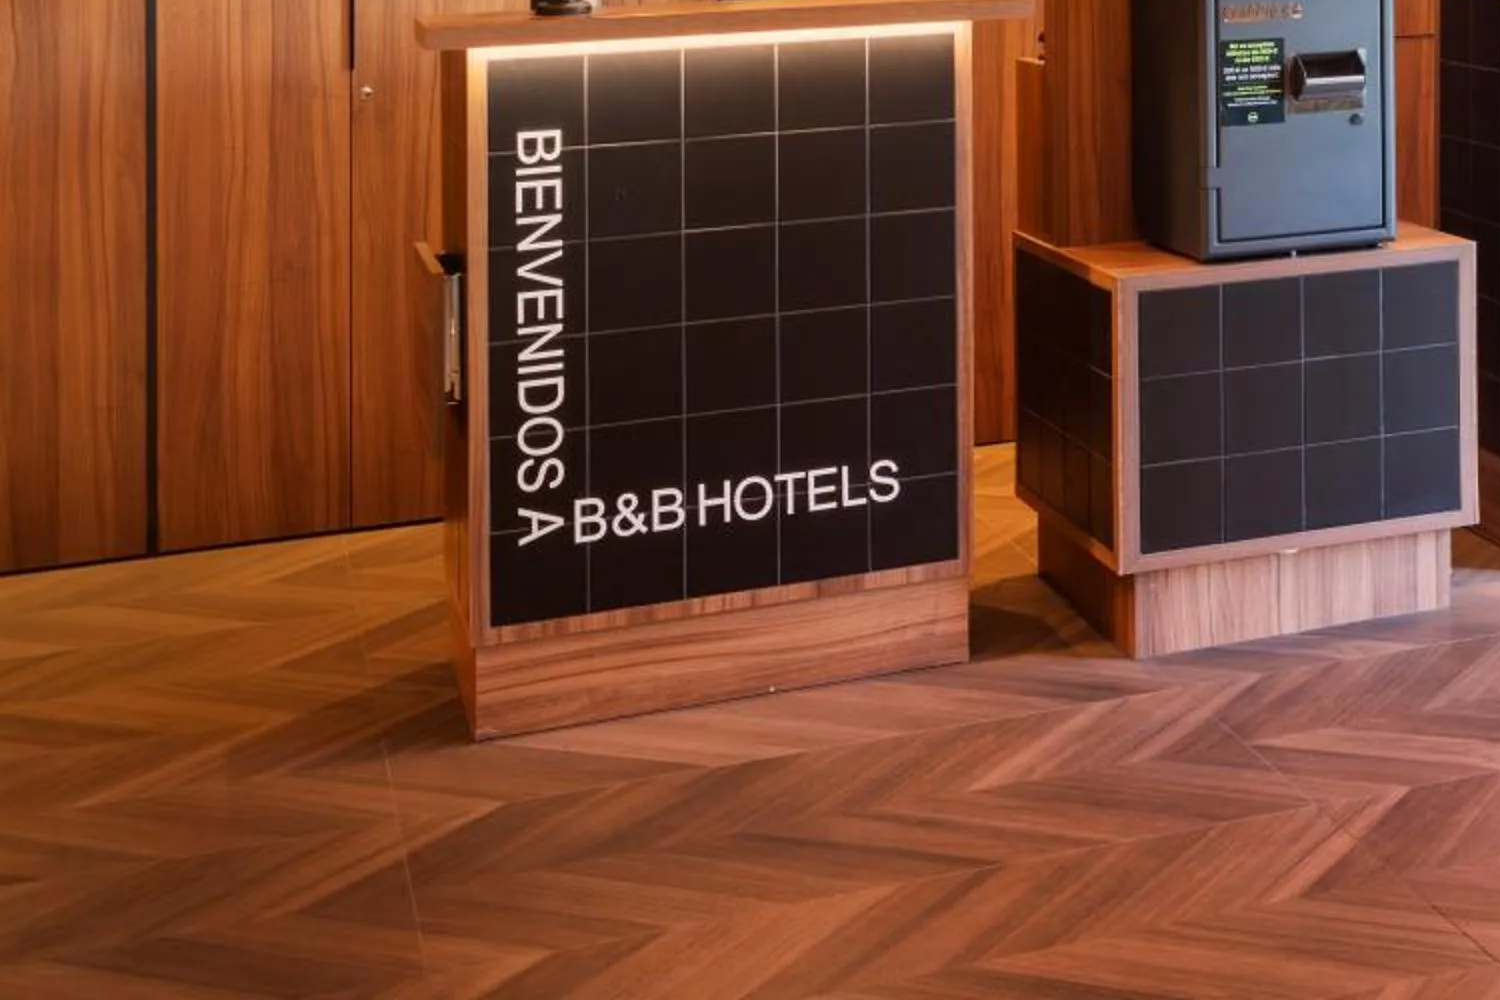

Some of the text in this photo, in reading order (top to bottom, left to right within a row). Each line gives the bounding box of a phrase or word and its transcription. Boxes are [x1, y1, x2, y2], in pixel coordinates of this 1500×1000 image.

[515, 128, 565, 547] BIENVENIDOS A
[573, 459, 901, 545] B&B HOTELS
